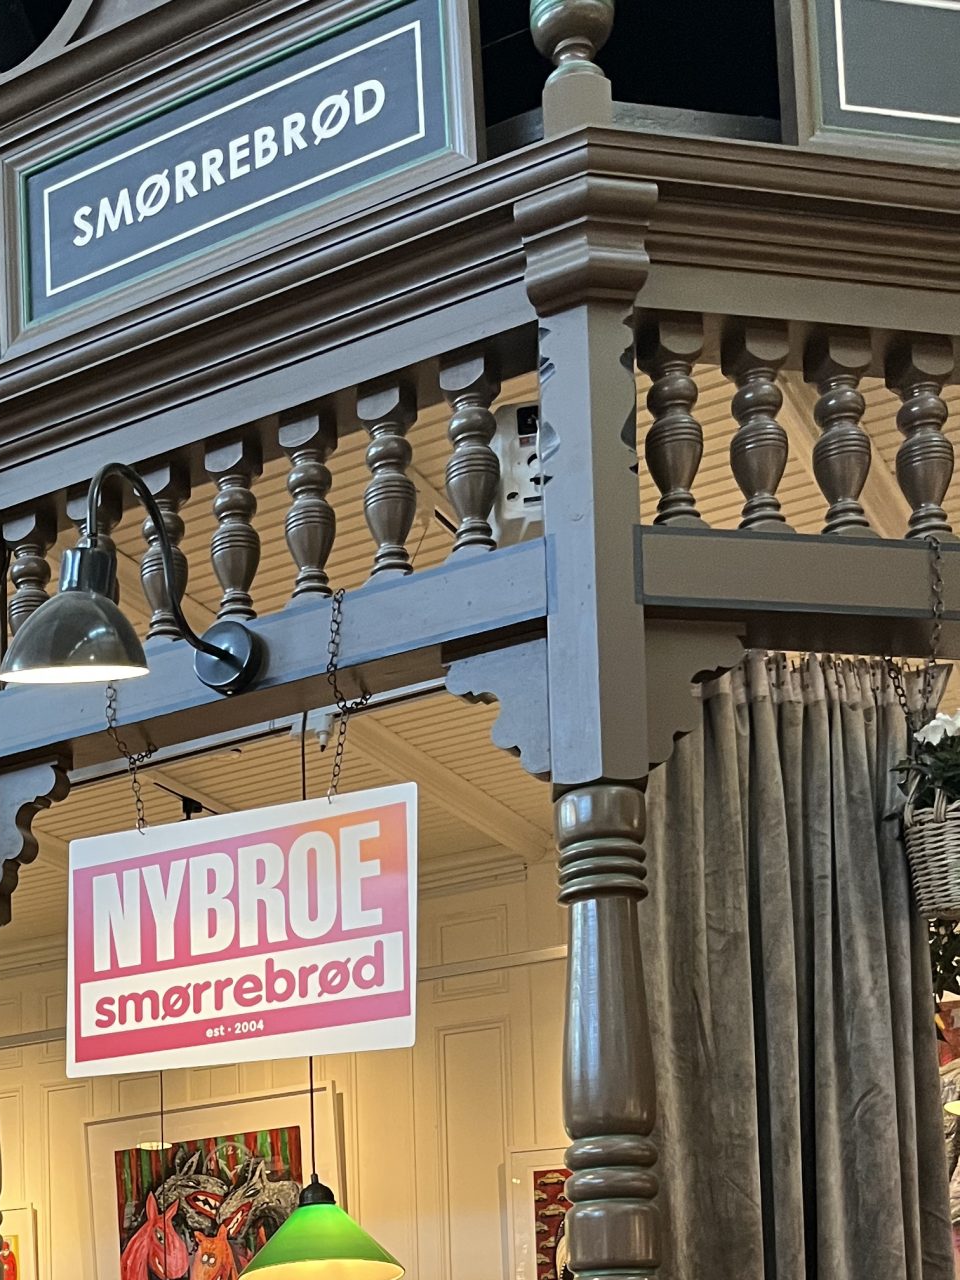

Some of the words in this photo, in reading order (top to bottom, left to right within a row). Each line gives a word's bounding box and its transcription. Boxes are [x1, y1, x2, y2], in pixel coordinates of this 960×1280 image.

[73, 80, 385, 247] SMØRREBRØD
[93, 820, 383, 973] NYBROE
[95, 939, 385, 1029] smørrebrød
[205, 1026, 225, 1038] est
[235, 1019, 264, 1034] 2004
